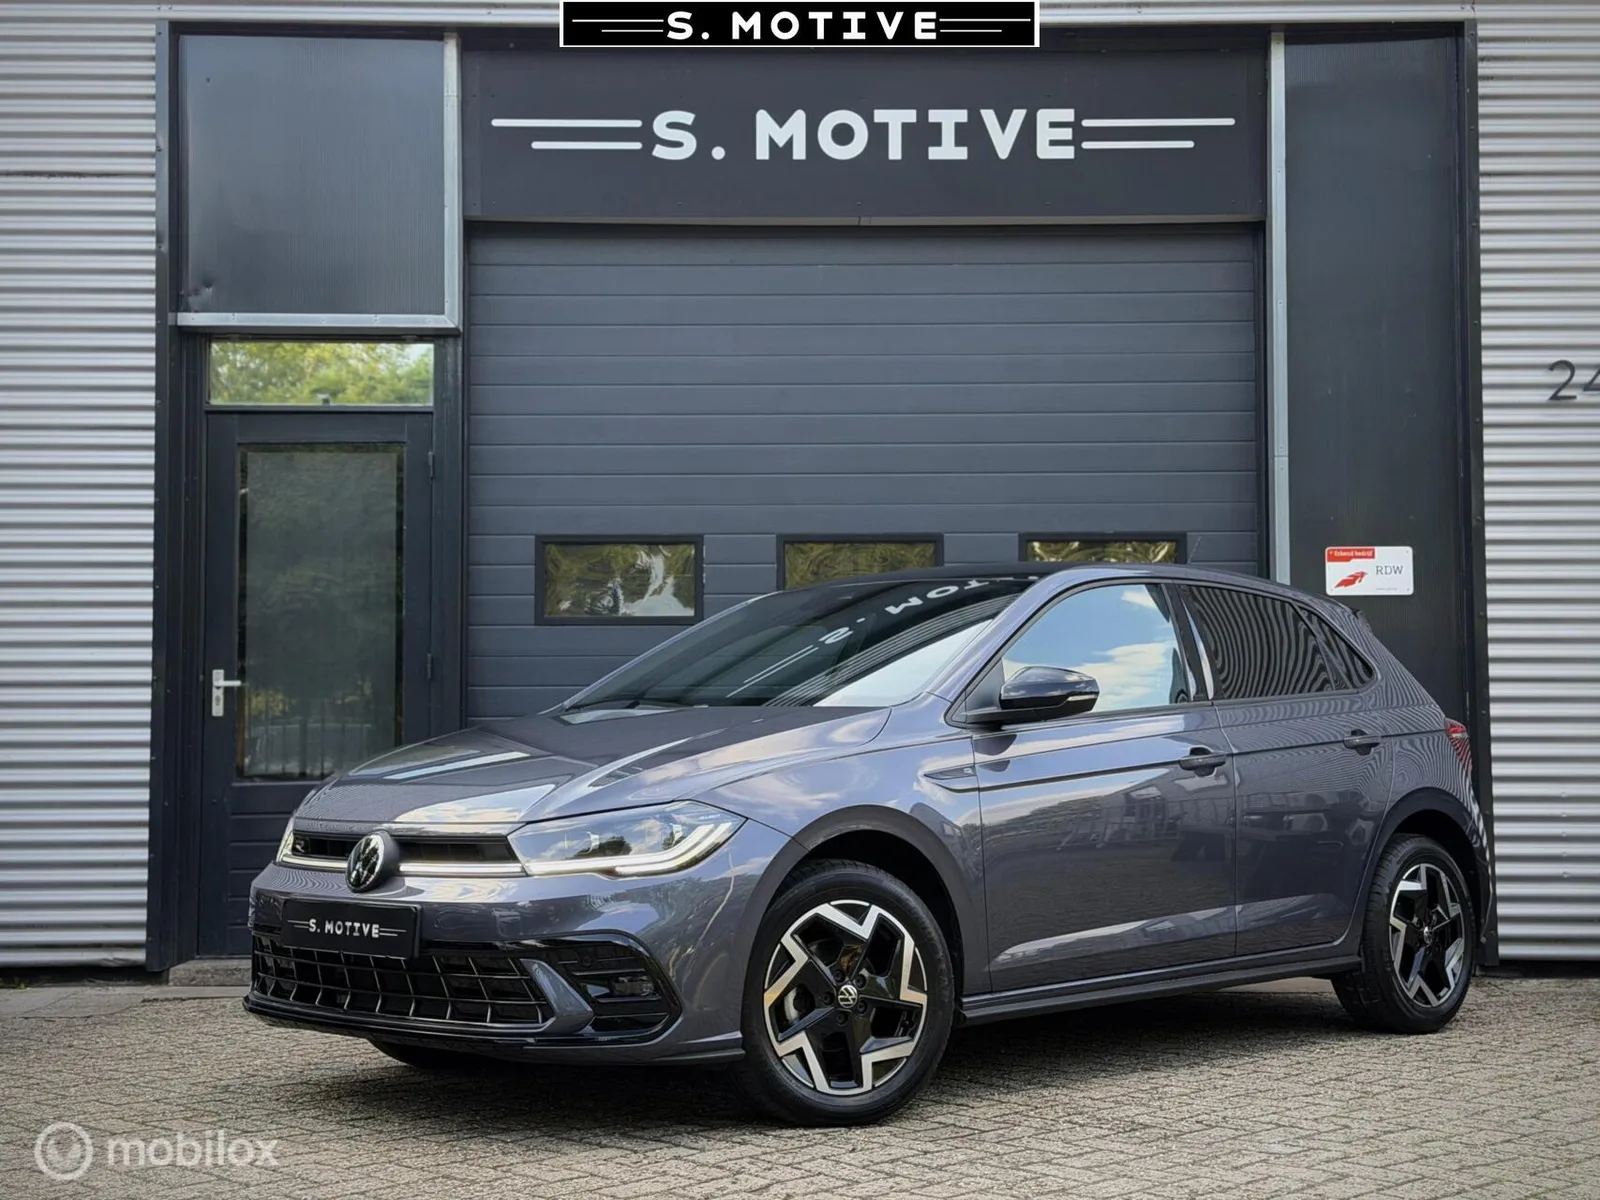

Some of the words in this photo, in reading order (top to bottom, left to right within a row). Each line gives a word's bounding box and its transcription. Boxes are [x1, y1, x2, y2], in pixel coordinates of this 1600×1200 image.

[651, 109, 726, 161] S.
[755, 108, 1076, 161] MOTIVE
[1376, 565, 1403, 575] RDW
[309, 919, 320, 932] S.
[325, 920, 380, 938] MOTIVE
